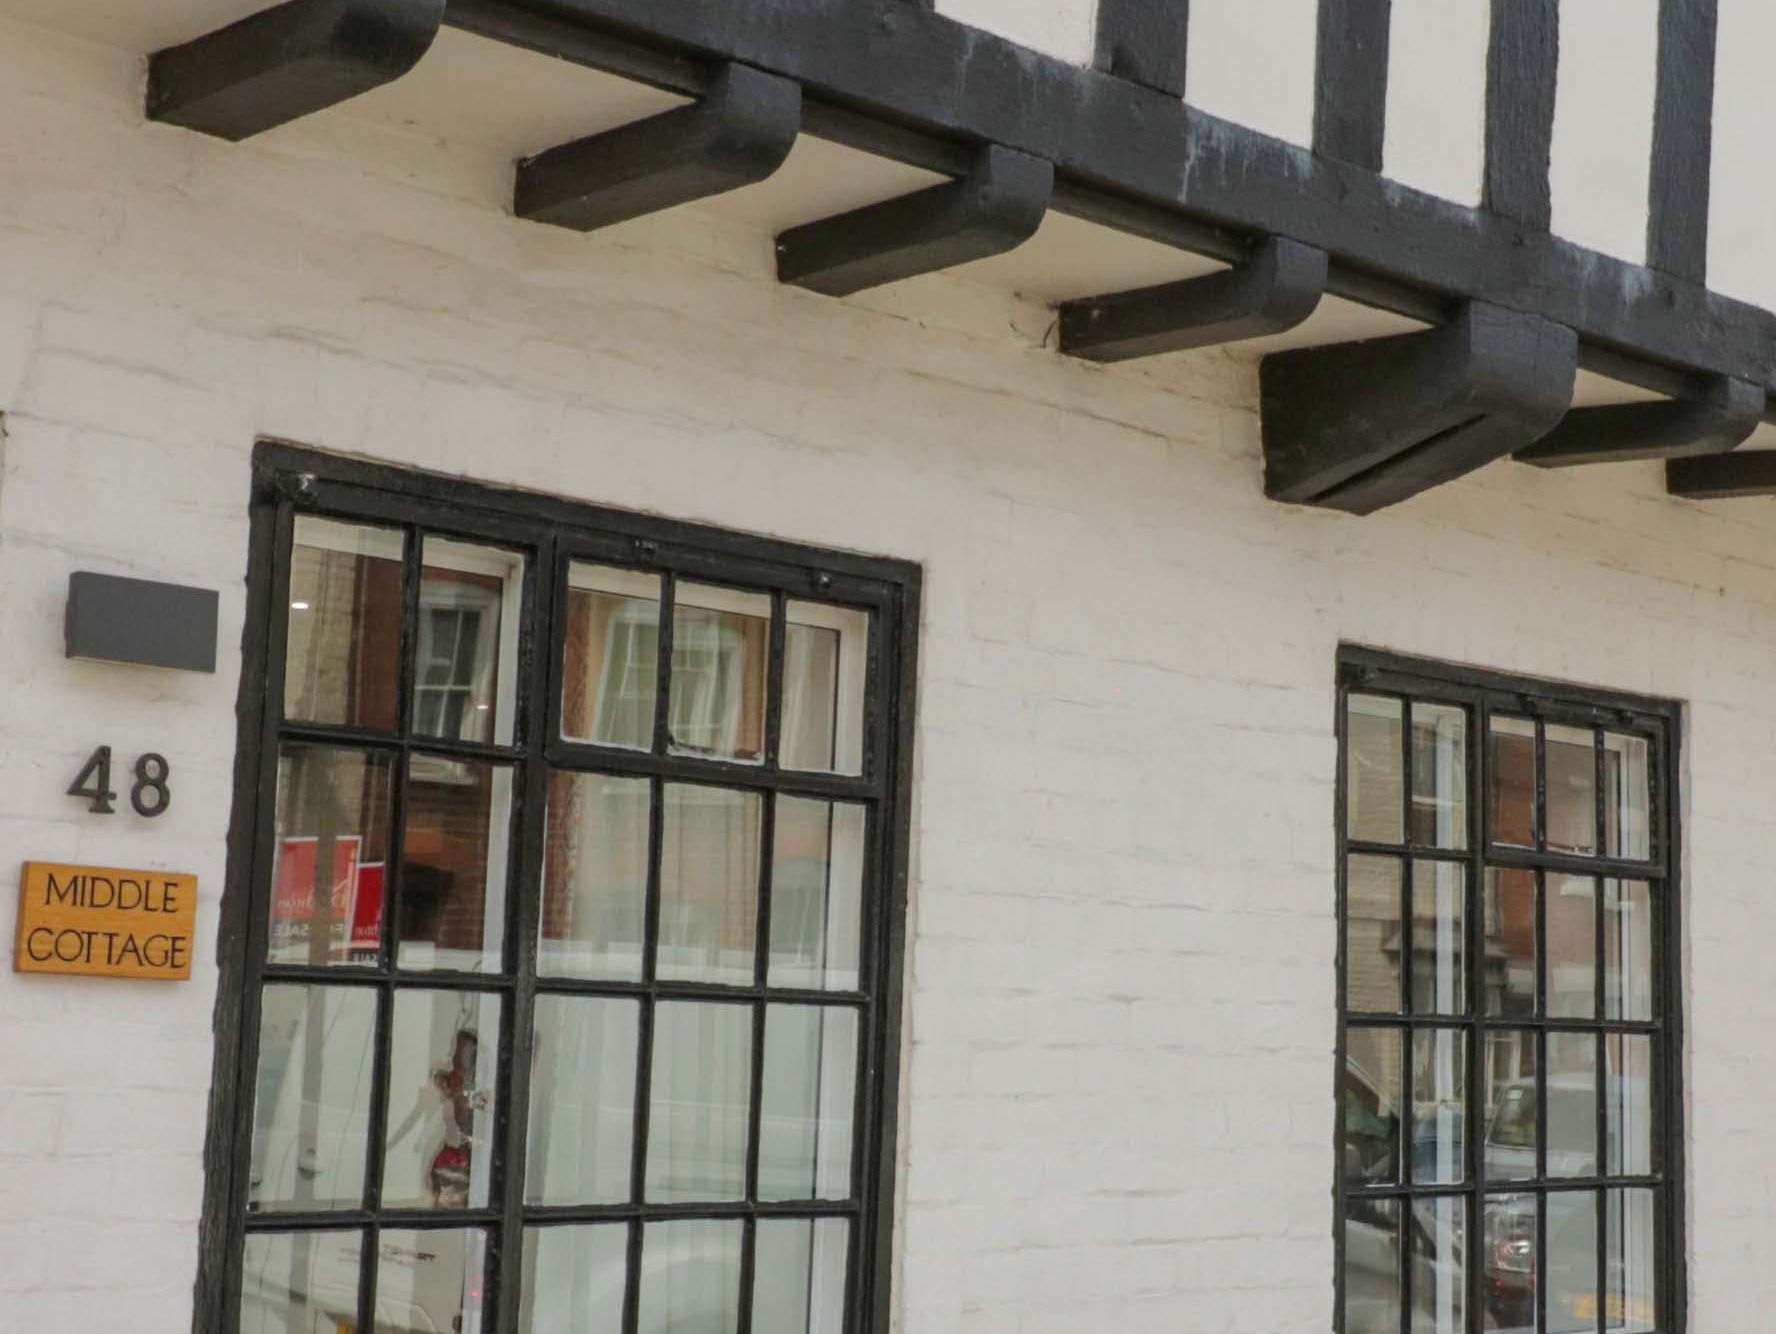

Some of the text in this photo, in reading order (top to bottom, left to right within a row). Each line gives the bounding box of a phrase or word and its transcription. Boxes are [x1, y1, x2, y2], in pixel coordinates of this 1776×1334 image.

[66, 744, 171, 818] 48
[44, 872, 180, 915] MIDDLE
[27, 927, 187, 970] COTTAGE
